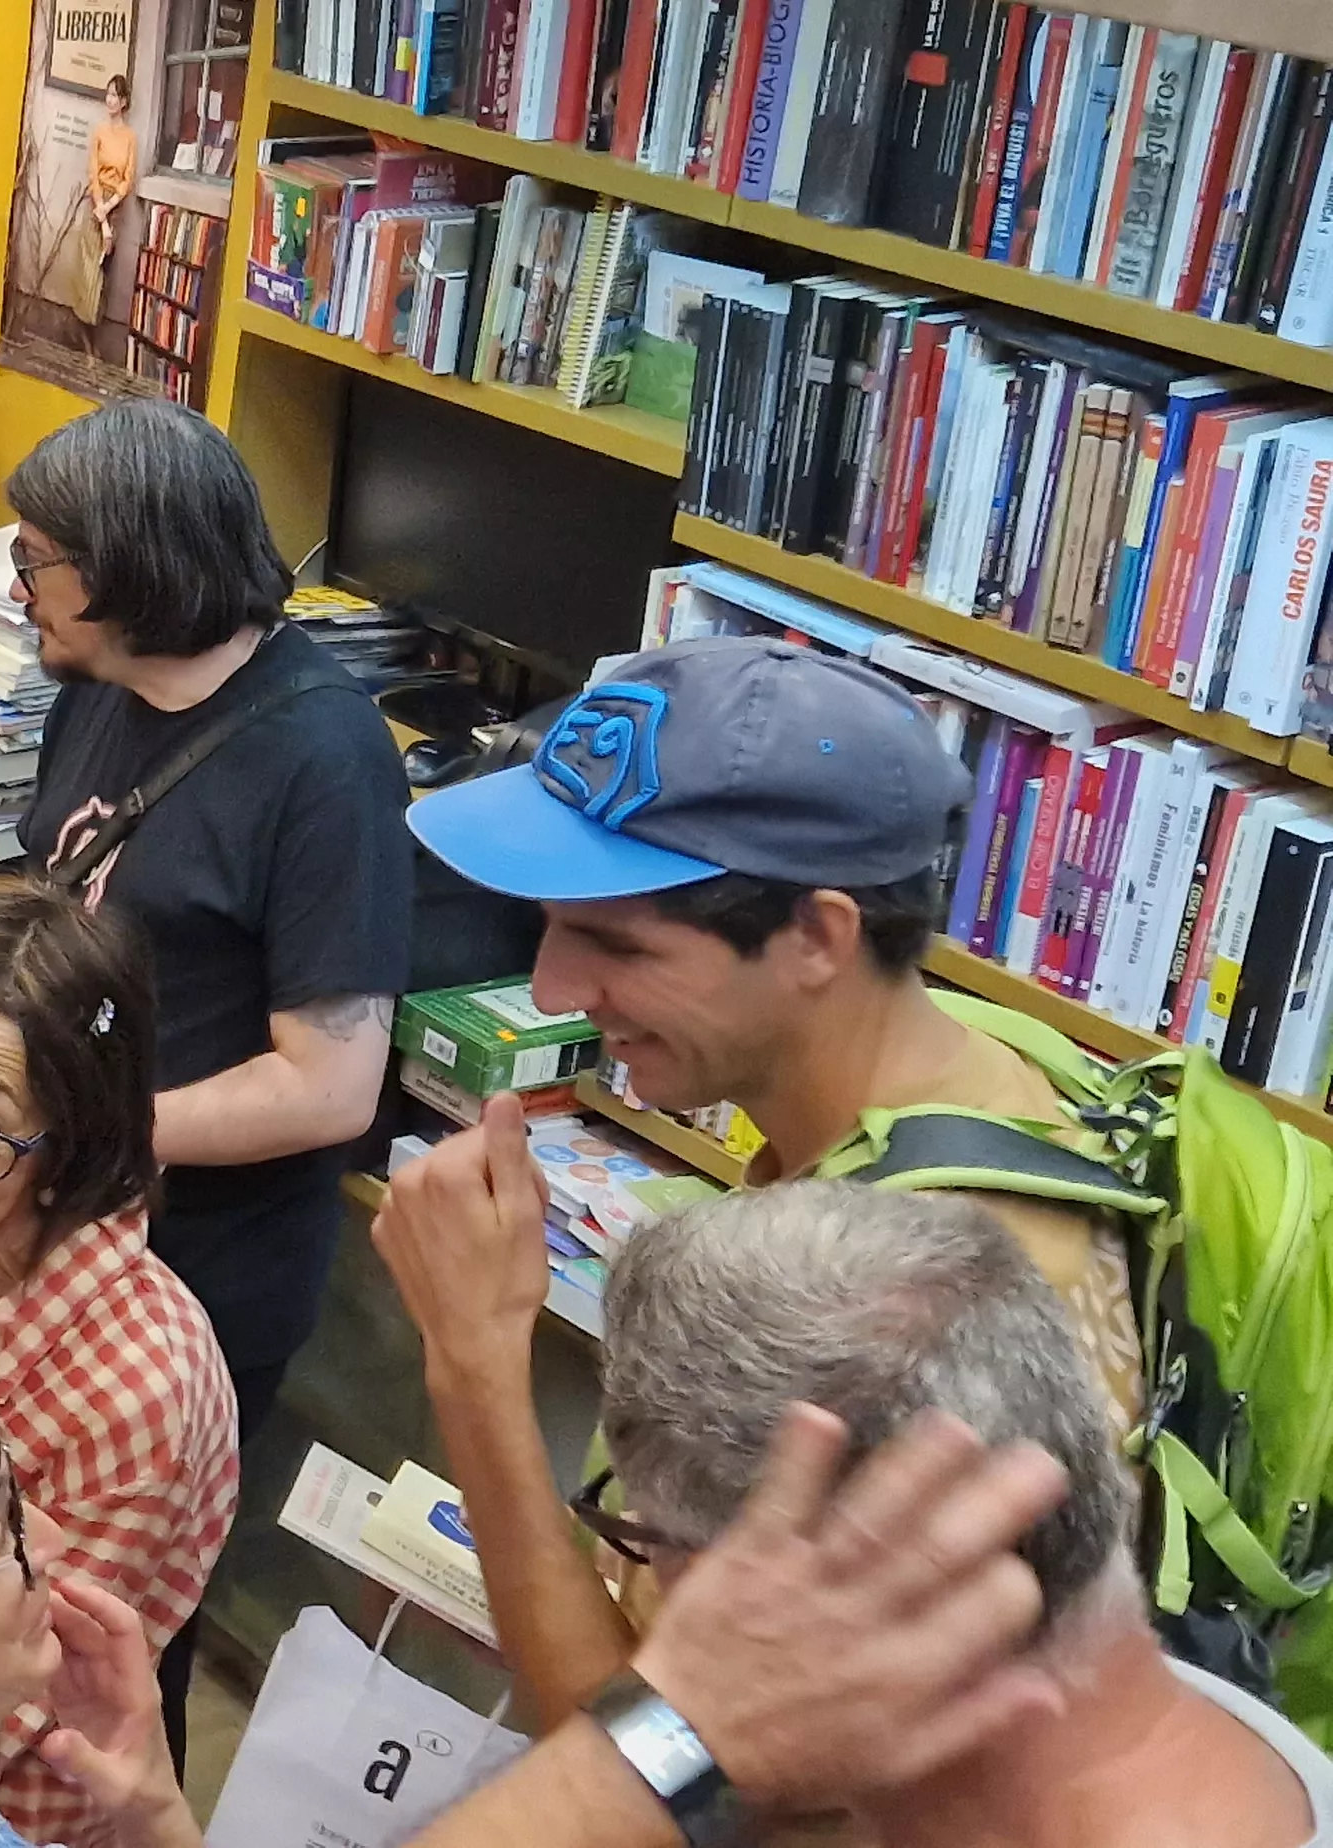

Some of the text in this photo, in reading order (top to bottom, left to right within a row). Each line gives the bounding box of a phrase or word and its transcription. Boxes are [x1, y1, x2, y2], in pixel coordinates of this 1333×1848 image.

[56, 4, 126, 43] LIBRERÍA
[1282, 458, 1333, 622] CARLOS SAURA
[363, 1739, 412, 1803] a
